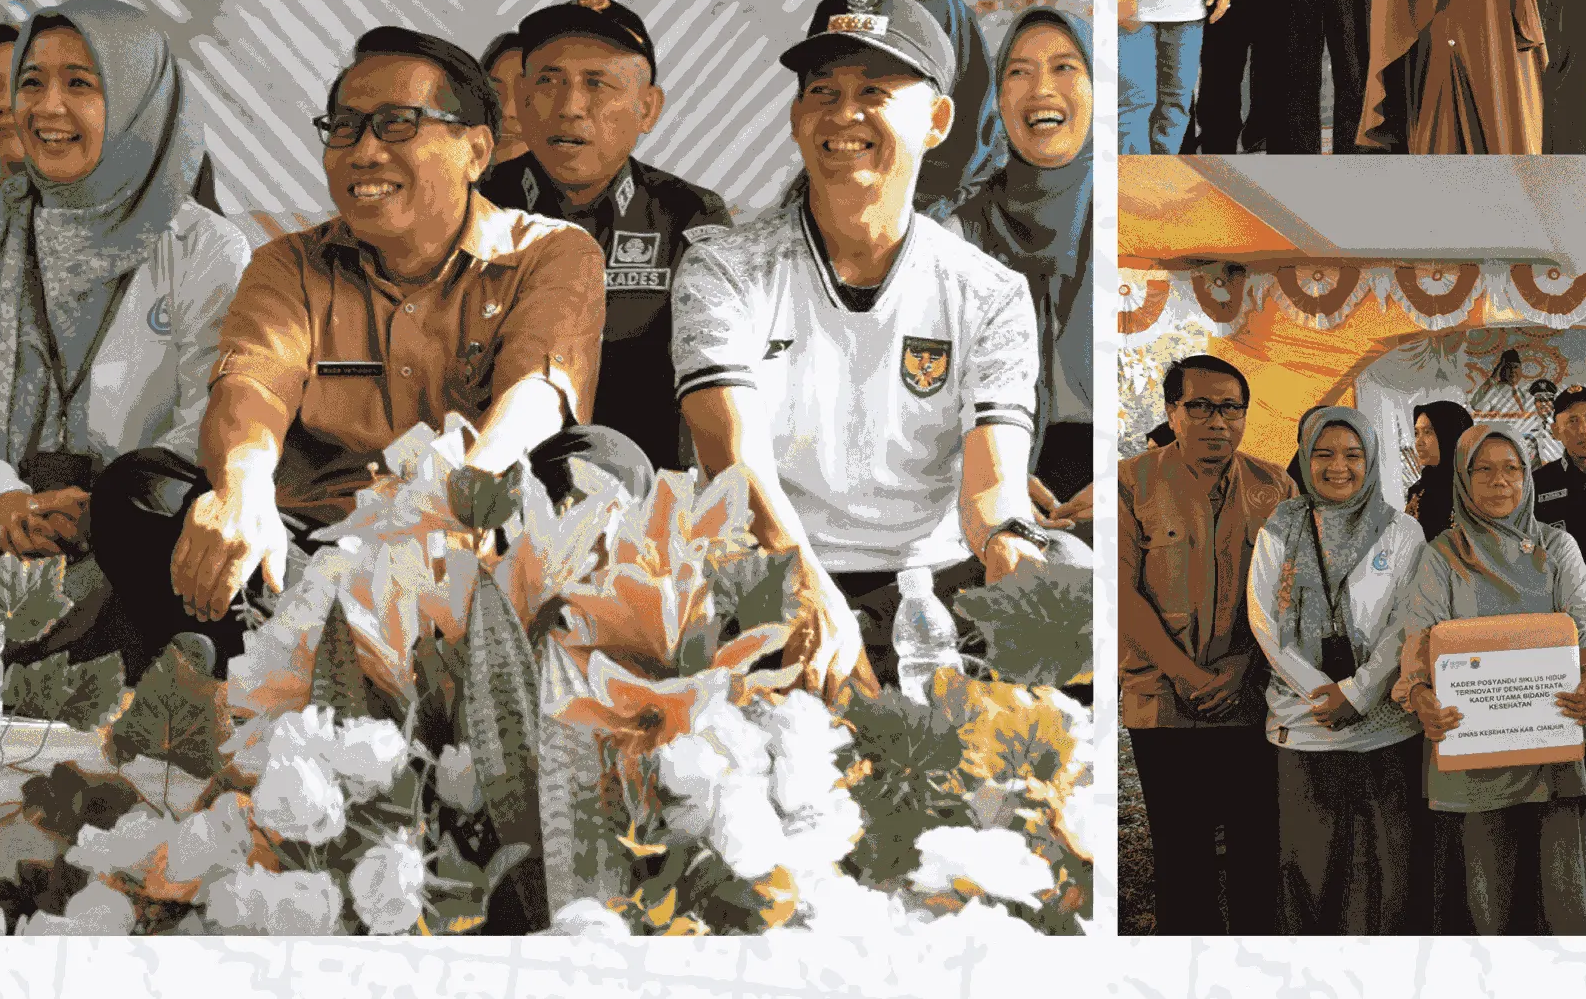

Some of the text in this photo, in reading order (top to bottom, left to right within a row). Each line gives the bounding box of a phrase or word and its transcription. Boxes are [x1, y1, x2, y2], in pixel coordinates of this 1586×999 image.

[1477, 678, 1516, 686] POSYANDU
[1503, 685, 1533, 693] DENGAN
[1489, 701, 1532, 710] KESEHATAN
[1479, 728, 1519, 737] KESEHATAN
